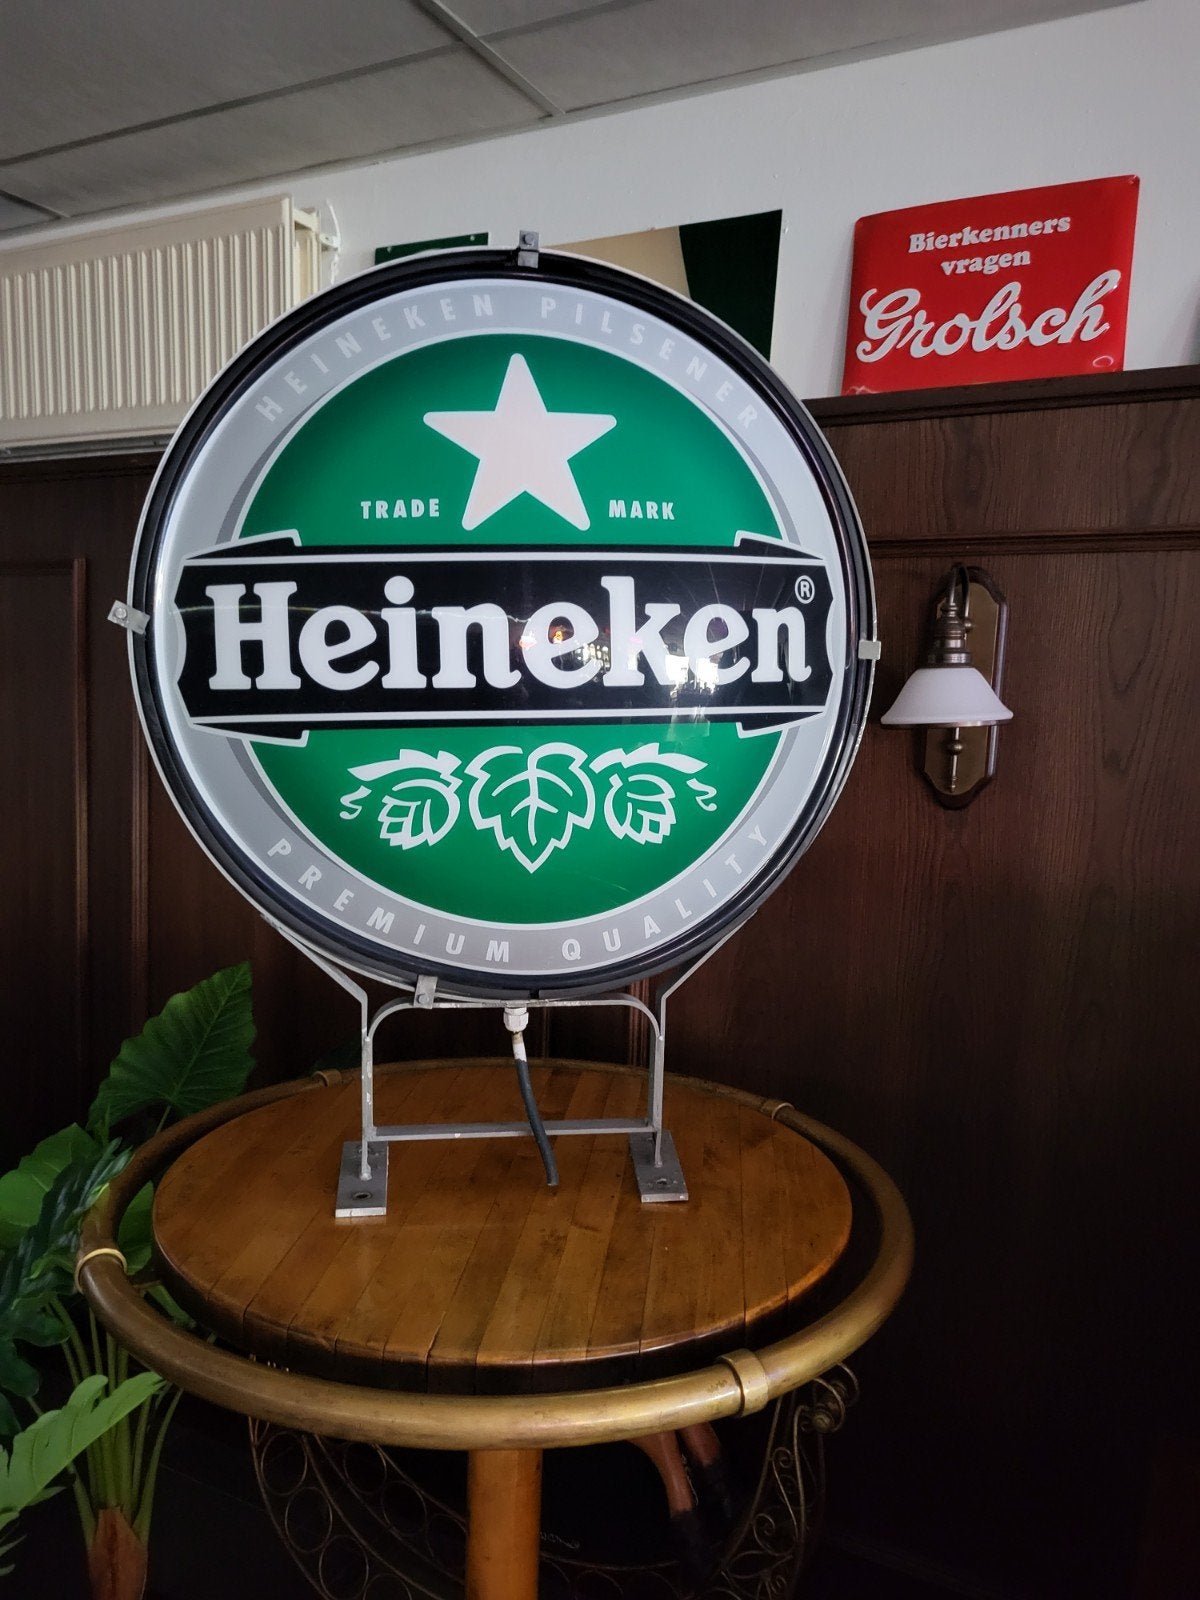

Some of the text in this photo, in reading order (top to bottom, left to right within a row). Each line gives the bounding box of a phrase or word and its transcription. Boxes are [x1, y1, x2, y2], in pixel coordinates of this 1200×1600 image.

[908, 216, 1071, 254] Bierkenners
[941, 251, 1031, 276] vragen
[255, 294, 758, 428] HEINEKEN PILSENER
[856, 270, 1121, 362] Grolsch
[361, 498, 675, 520] TRADE MARK
[205, 576, 812, 691] Heineken
[268, 825, 767, 962] PREMIUM QUALITY
